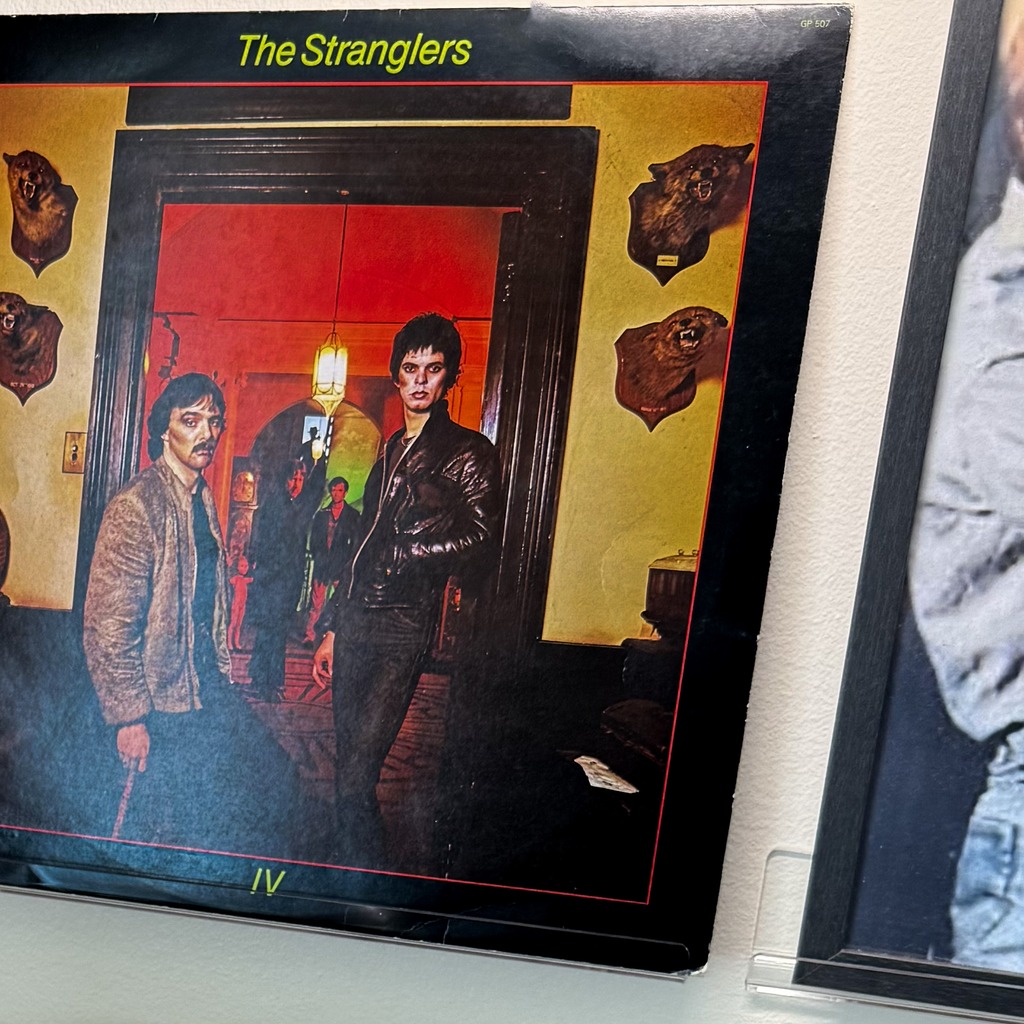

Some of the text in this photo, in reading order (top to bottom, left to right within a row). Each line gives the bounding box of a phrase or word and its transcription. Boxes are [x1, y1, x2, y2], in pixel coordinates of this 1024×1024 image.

[800, 20, 831, 28] GP 507
[239, 32, 473, 75] The Stranglers
[250, 867, 287, 896] IV
